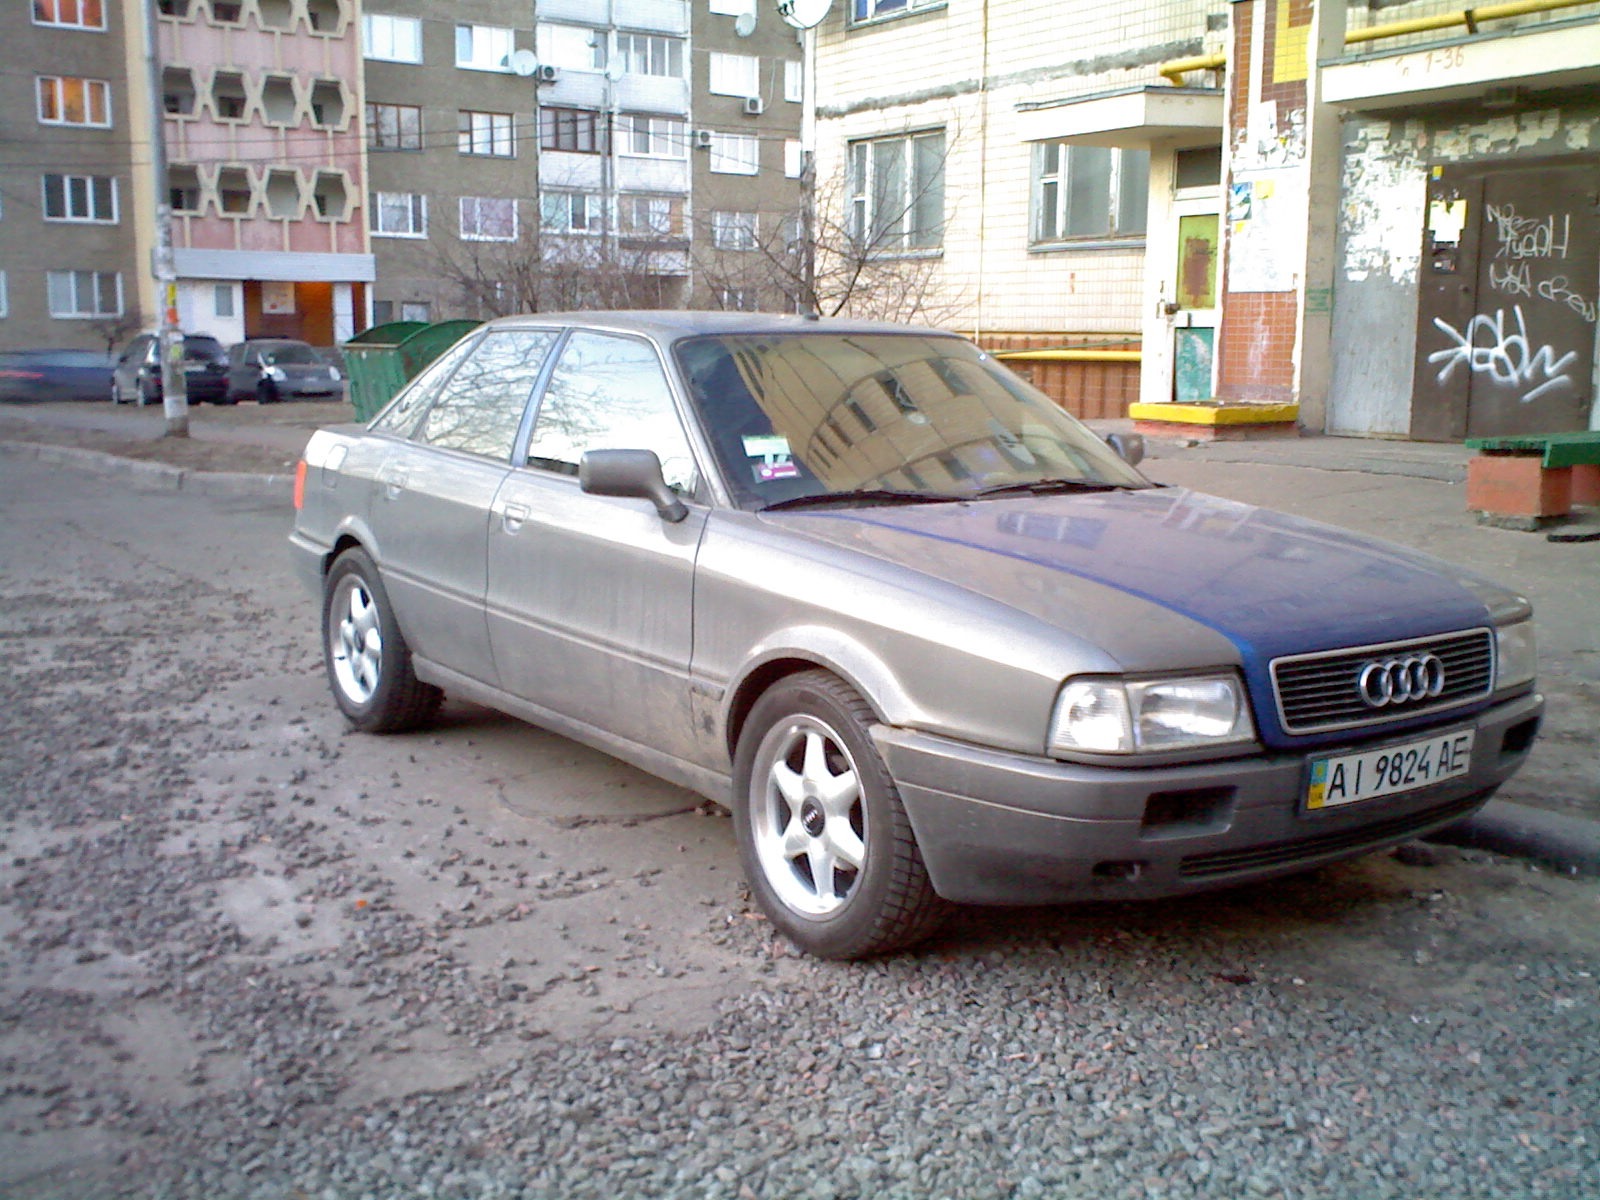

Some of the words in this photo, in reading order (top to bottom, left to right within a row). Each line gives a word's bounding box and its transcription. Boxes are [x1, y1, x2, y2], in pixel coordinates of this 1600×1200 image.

[1327, 760, 1362, 800] AI
[1374, 746, 1430, 790] 9824
[1436, 736, 1468, 777] AE
